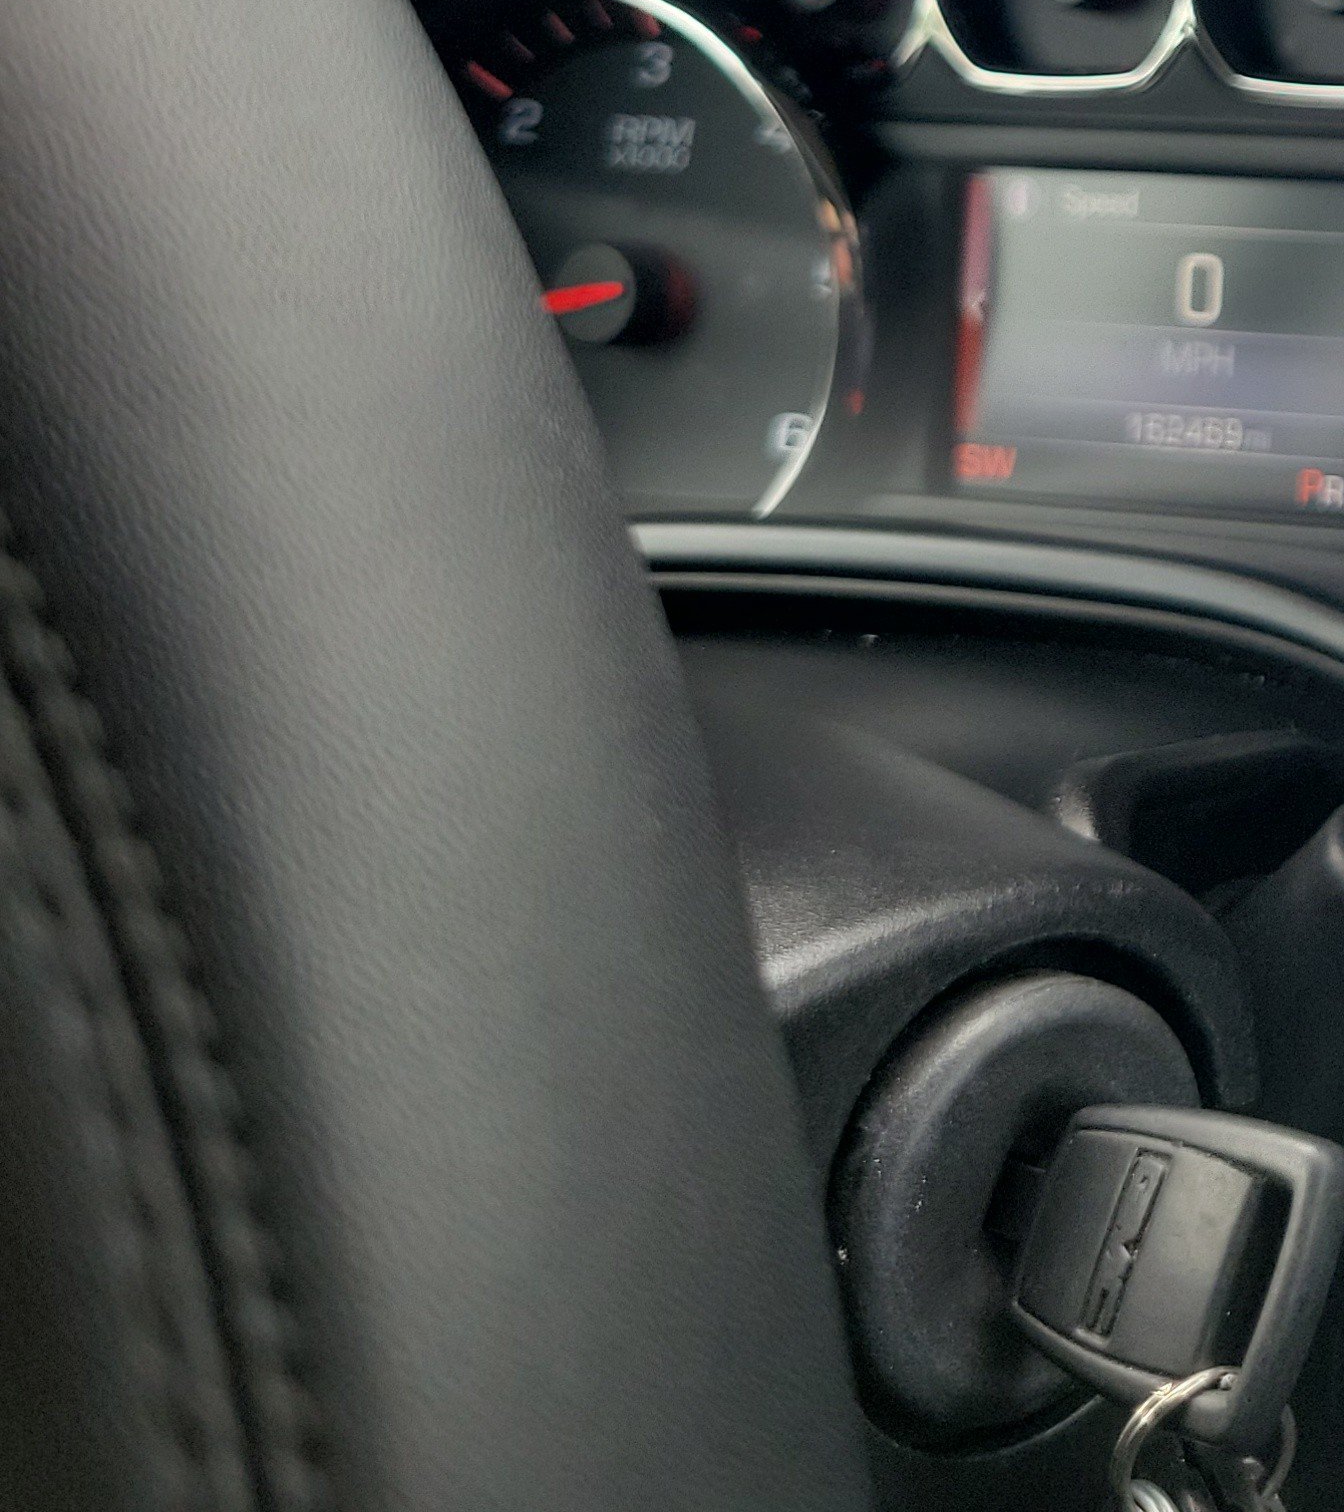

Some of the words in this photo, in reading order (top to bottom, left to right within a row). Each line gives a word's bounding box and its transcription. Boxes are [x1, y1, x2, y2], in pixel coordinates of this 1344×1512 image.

[636, 41, 674, 87] 3
[503, 97, 544, 144] 2
[612, 114, 696, 146] RPM
[1176, 252, 1224, 326] 0
